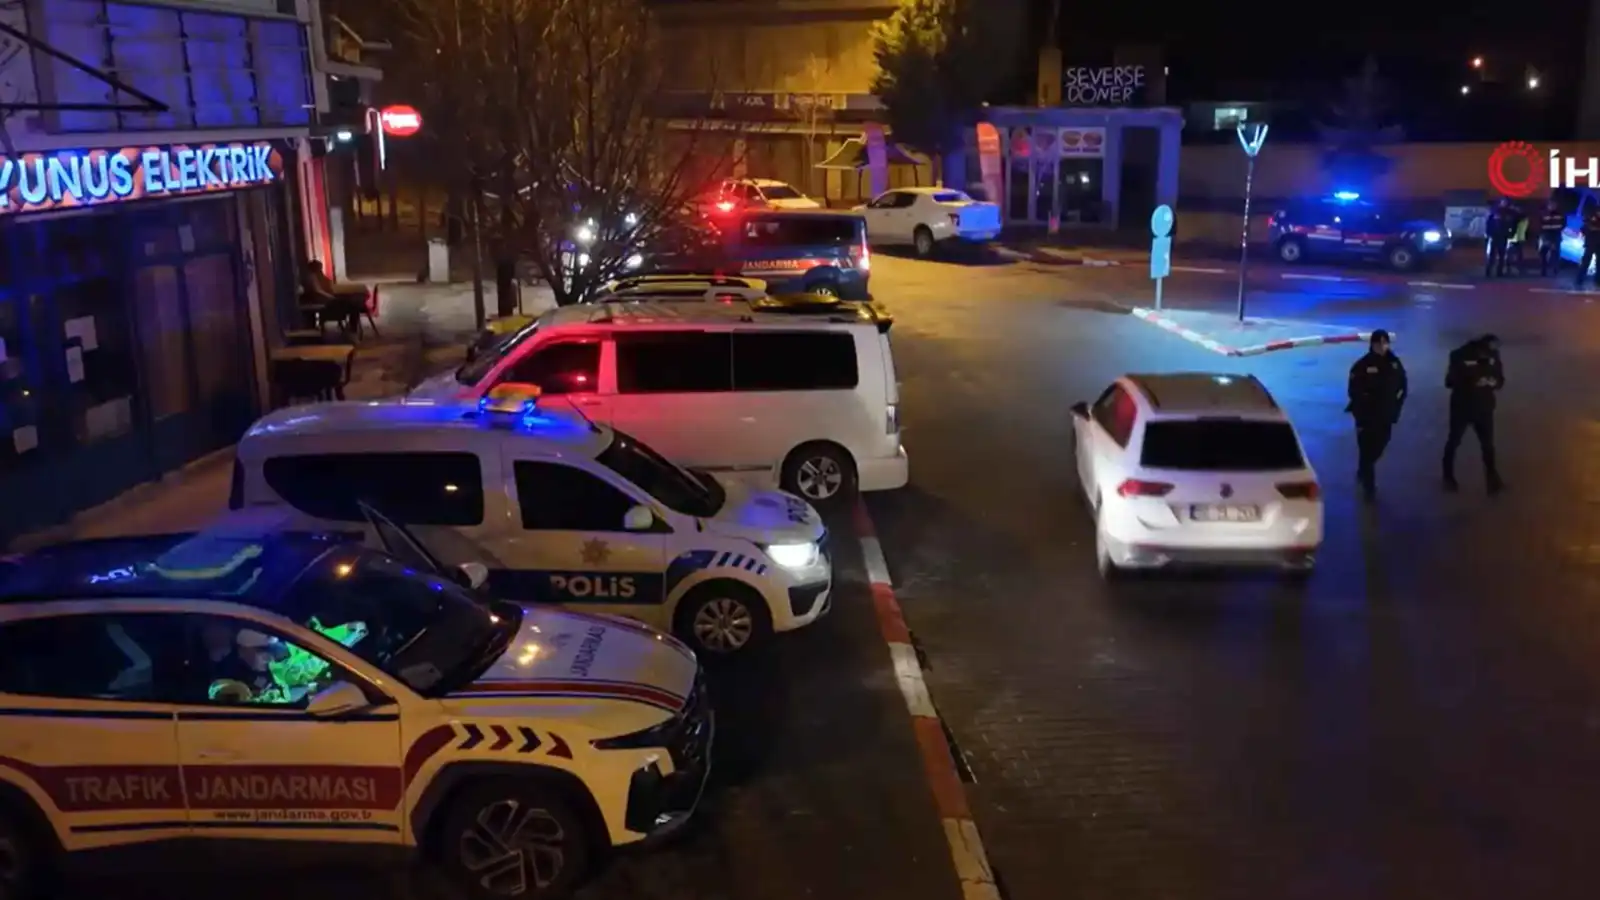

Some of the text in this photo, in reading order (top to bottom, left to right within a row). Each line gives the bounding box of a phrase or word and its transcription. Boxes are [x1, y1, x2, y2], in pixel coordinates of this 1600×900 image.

[1066, 66, 1145, 87] SEVERSE
[742, 259, 799, 270] JANDARMA
[195, 775, 377, 803] JANDARMASI
